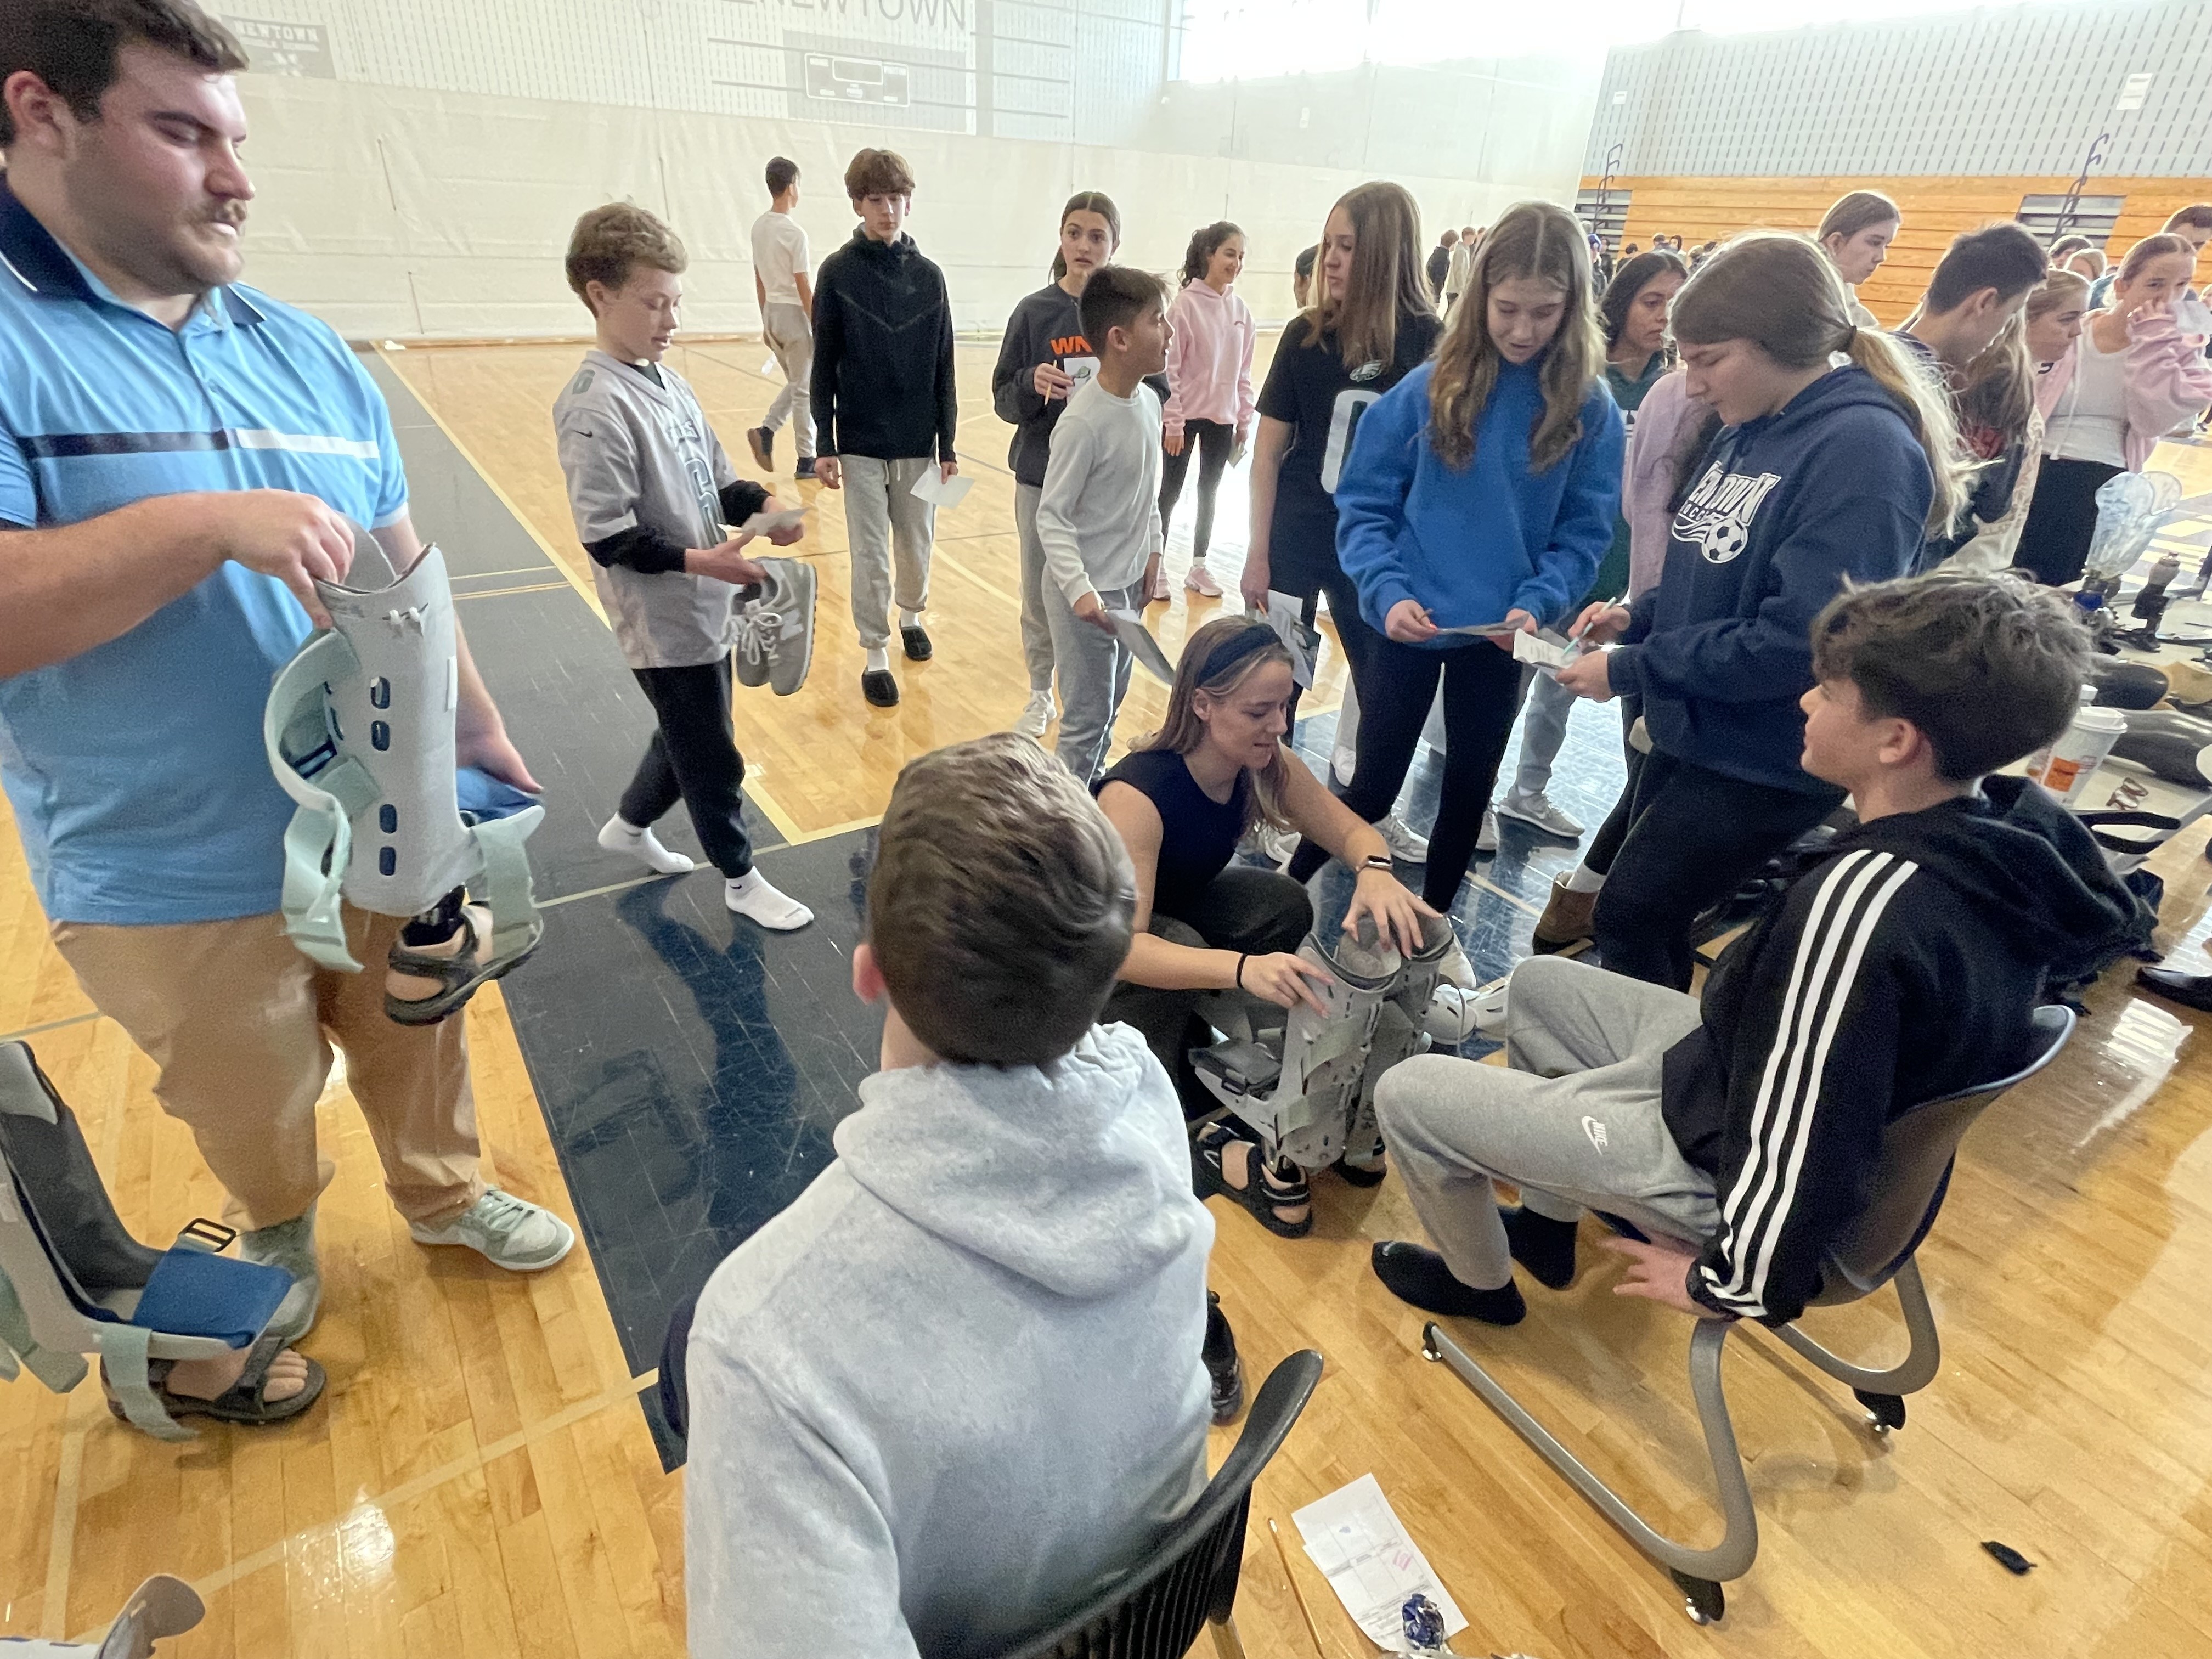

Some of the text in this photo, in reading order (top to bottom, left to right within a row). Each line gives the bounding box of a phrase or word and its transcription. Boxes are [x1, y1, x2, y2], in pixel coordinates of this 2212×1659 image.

[760, 0, 966, 30] TOWN
[233, 20, 319, 42] NEWTOWN
[1688, 460, 1781, 526] EWOWN
[1592, 1121, 1609, 1147] NIKE
